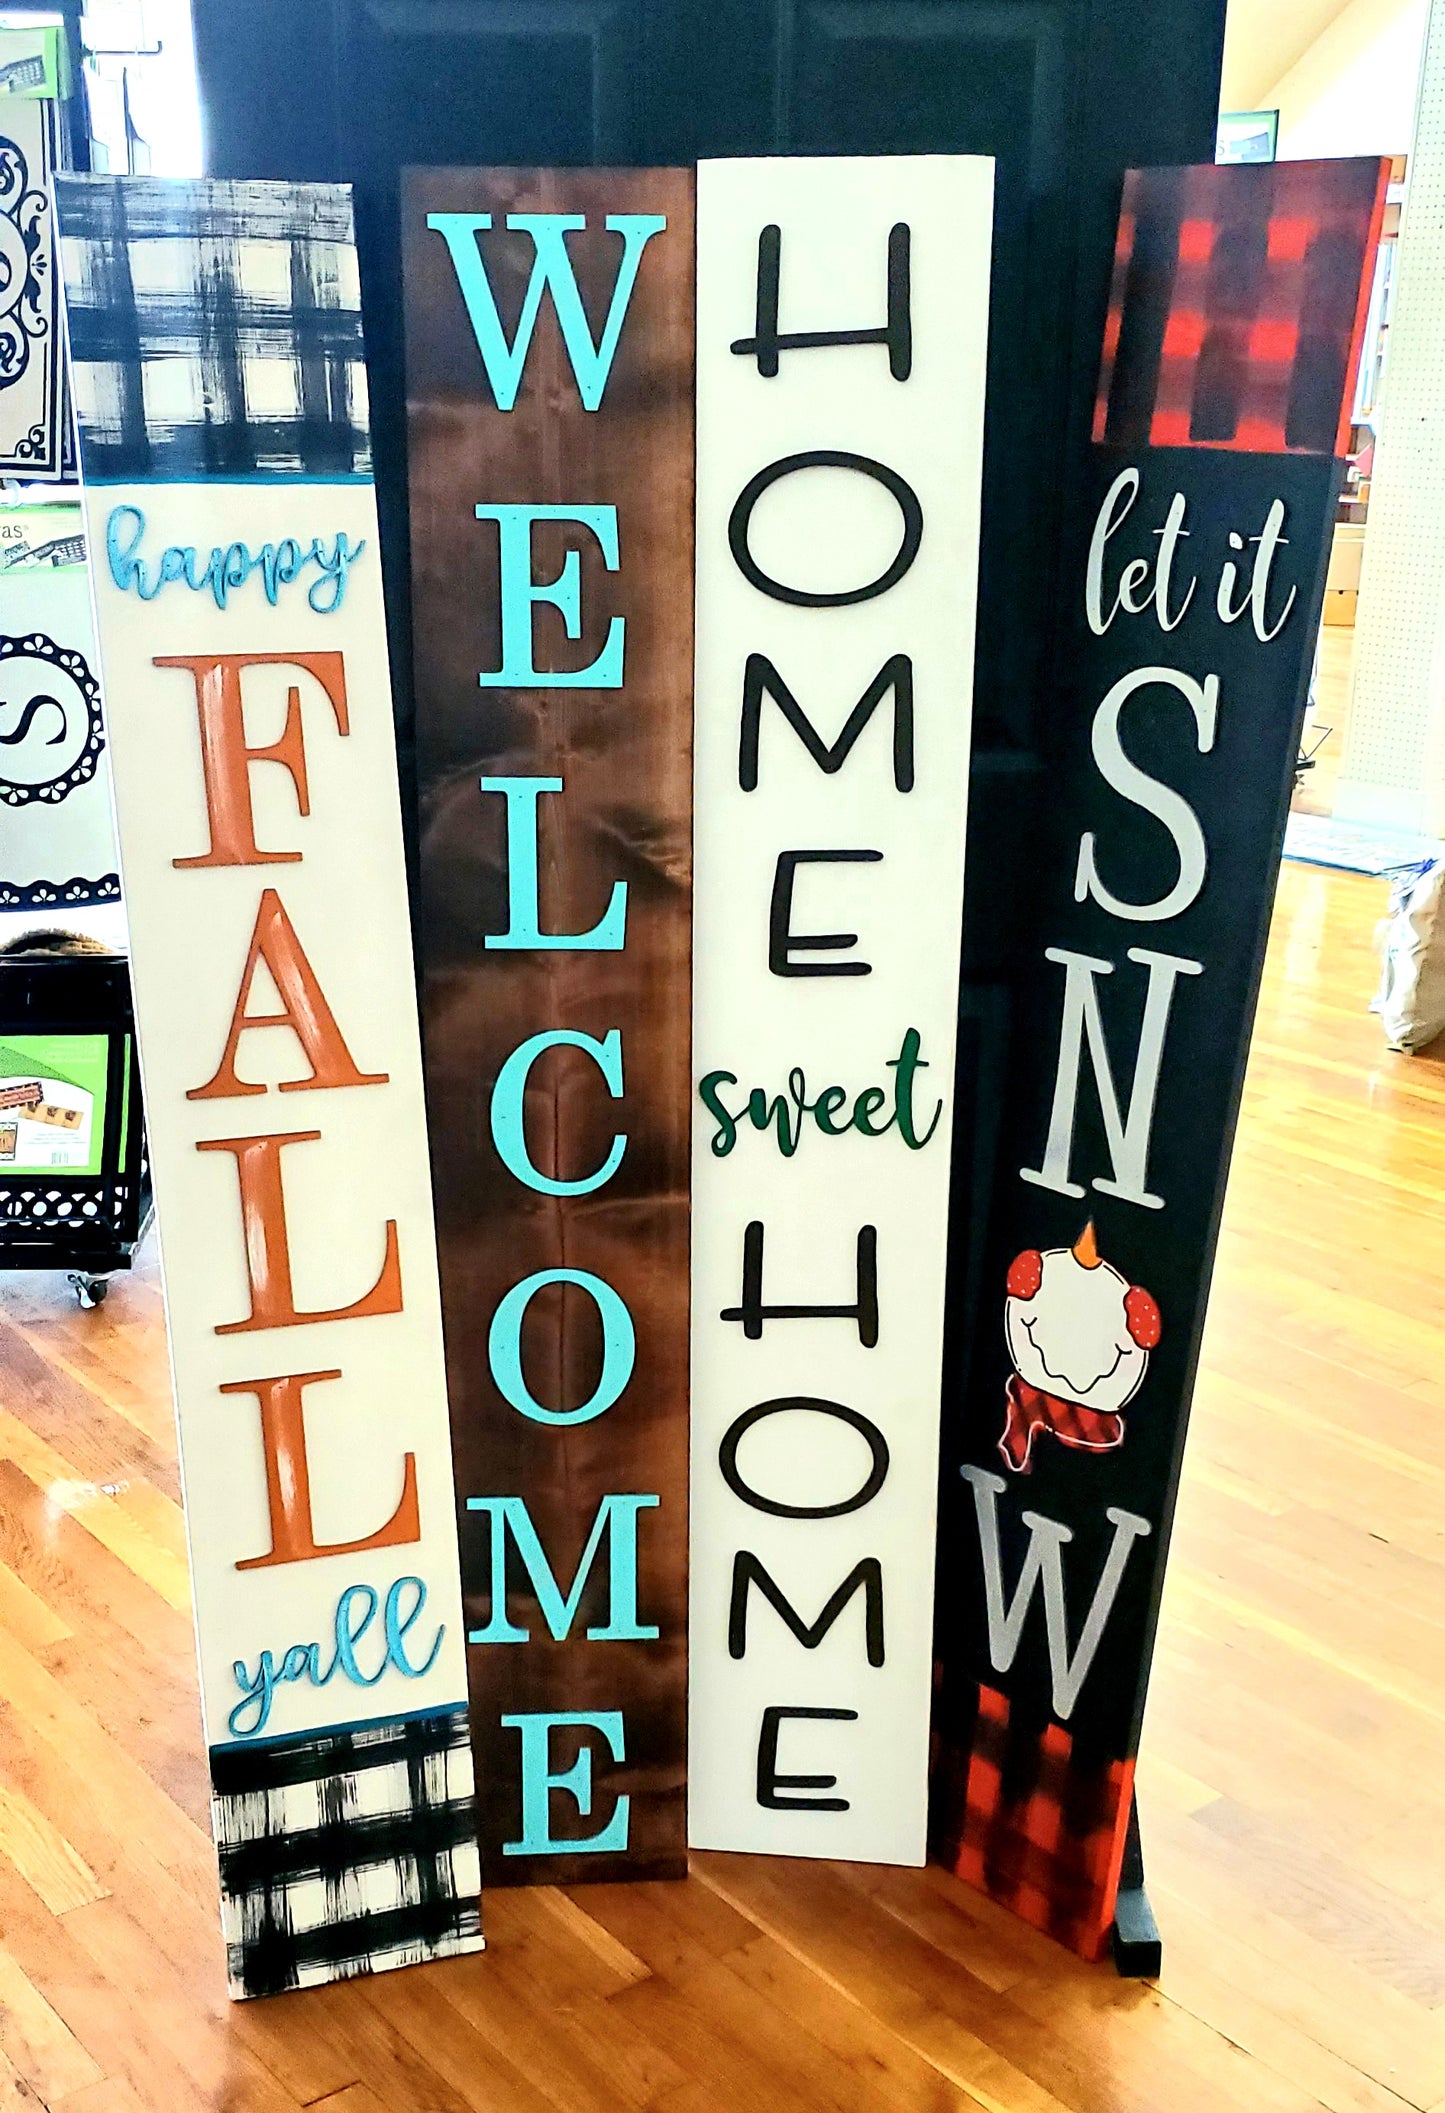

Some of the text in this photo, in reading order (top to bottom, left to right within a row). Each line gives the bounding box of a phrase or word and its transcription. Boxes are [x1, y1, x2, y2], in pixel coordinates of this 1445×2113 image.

[0, 525, 23, 539] as
[107, 505, 366, 615] happy
[728, 222, 923, 978] HOME
[1086, 467, 1297, 642] let it
[152, 651, 421, 1571] FALL
[426, 211, 666, 1857] WELCOME
[698, 1027, 943, 1158] sweet
[718, 1220, 890, 1812] HOME
[228, 1576, 445, 1738] yall
